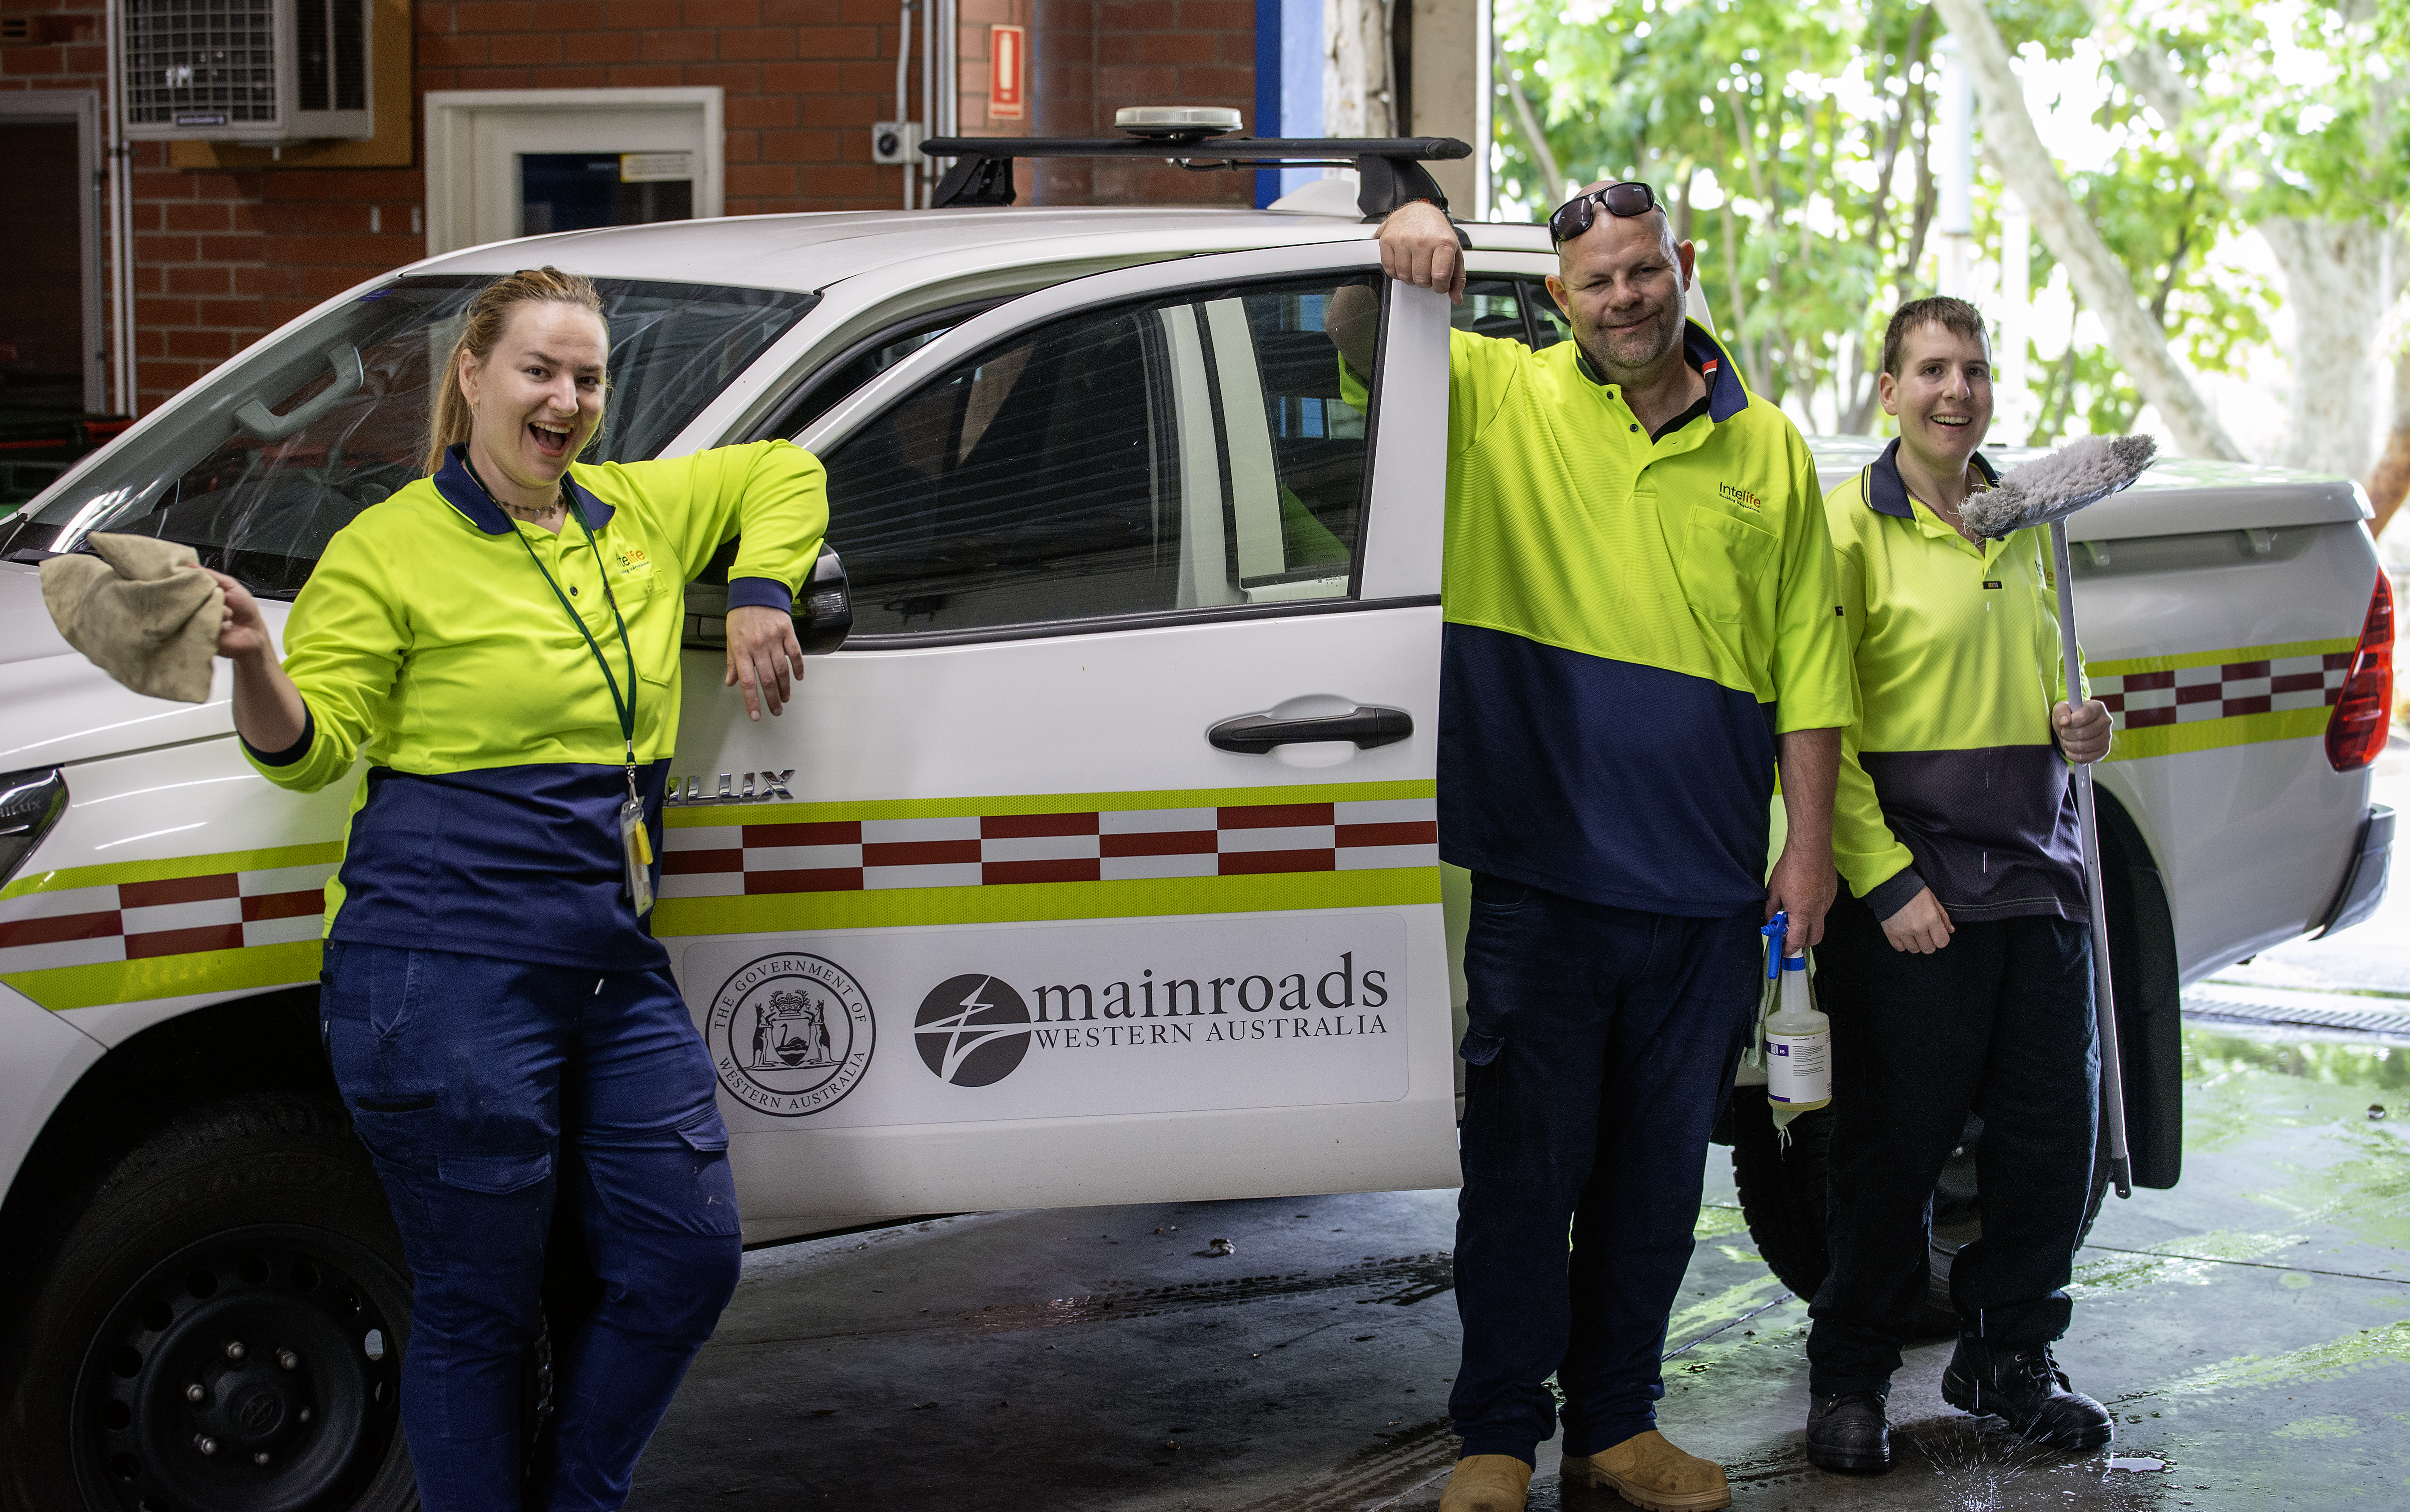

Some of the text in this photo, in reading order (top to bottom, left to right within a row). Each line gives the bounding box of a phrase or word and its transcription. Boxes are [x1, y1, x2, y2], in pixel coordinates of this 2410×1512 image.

[1720, 482, 1760, 508] Intelife
[667, 769, 796, 804] ILUX
[715, 960, 867, 1029] THE GOVERNMENT OF
[1032, 951, 1389, 1022] mainroads
[1033, 1013, 1388, 1049] WESTERN AUSTRALIA
[719, 1052, 865, 1109] WESTERN AUSTRALIA
